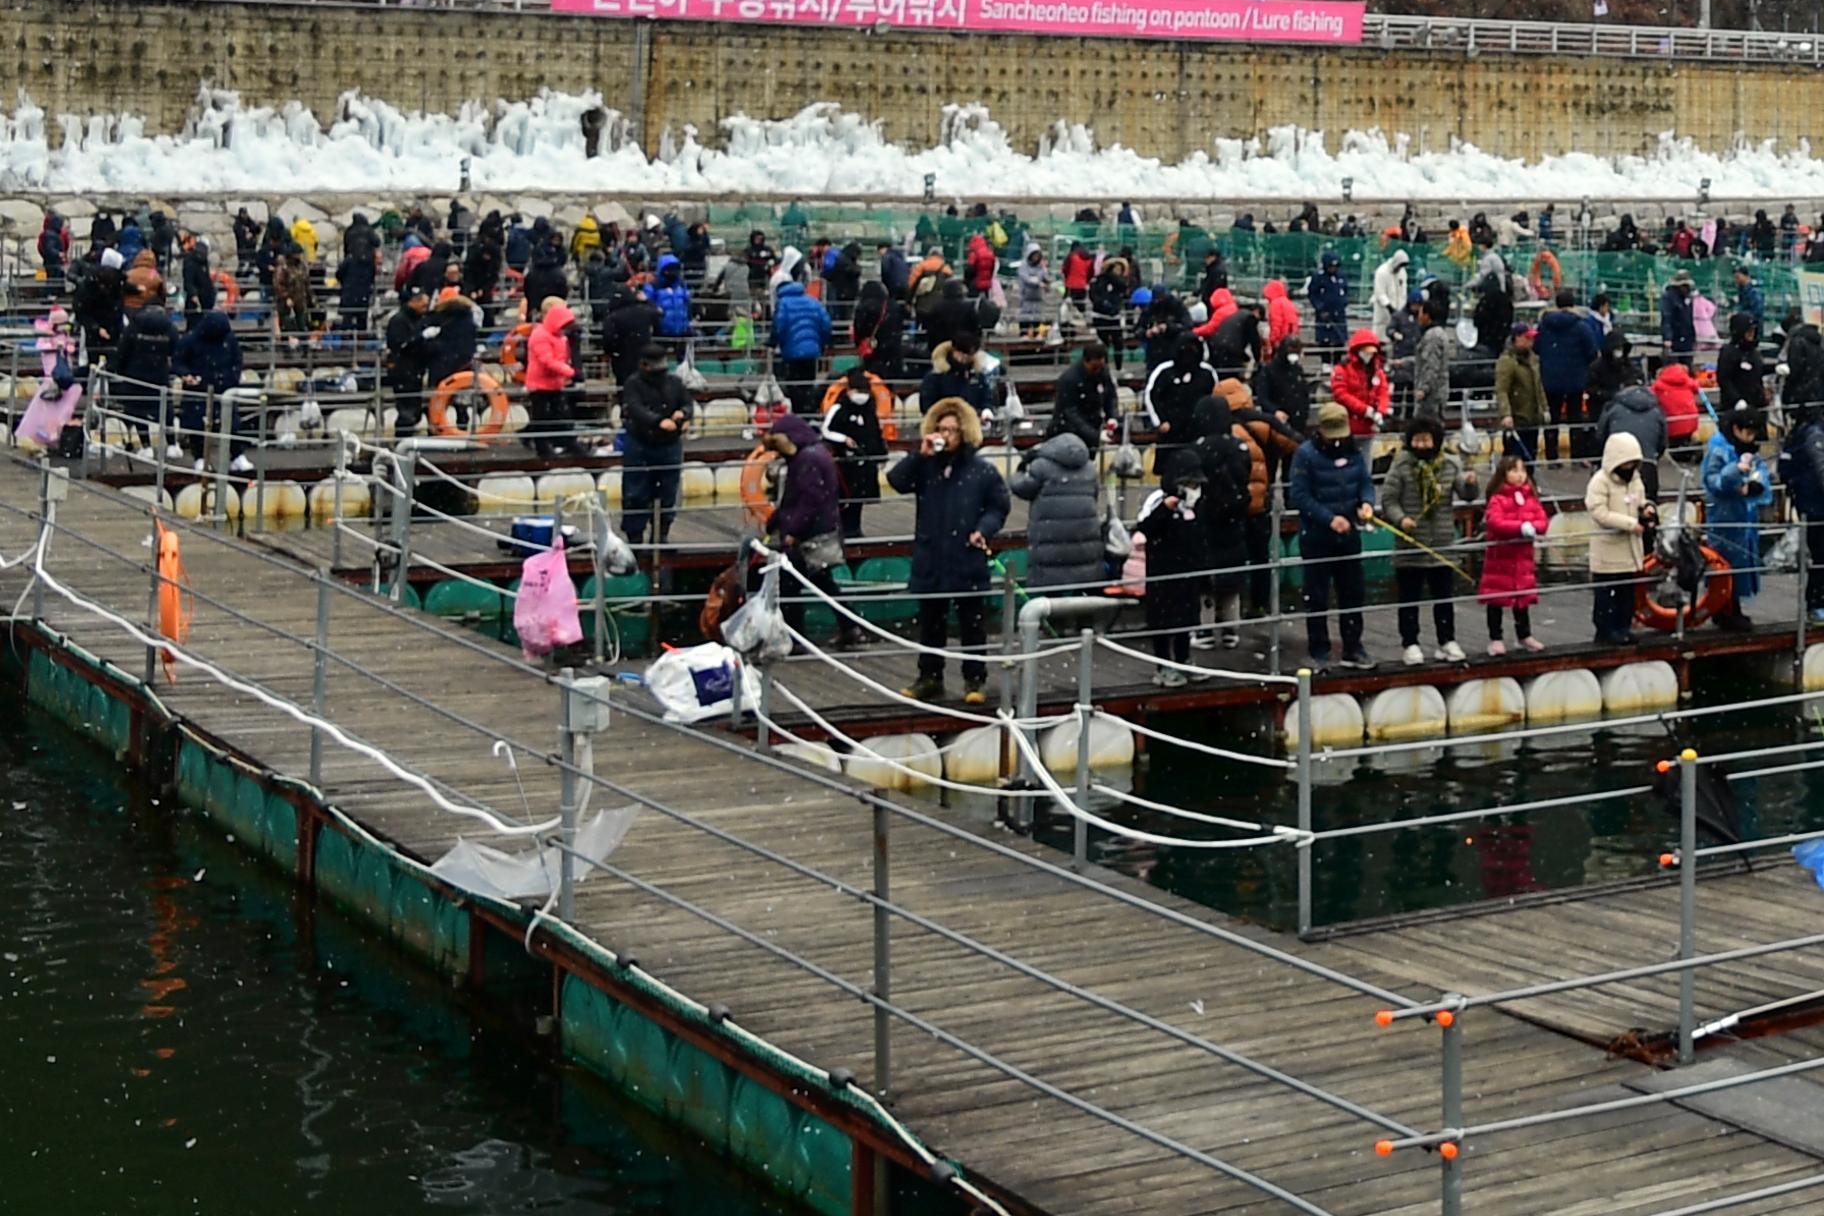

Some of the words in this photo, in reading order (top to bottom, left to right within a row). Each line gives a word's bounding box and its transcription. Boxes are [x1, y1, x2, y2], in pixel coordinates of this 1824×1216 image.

[1091, 0, 1148, 32] fishing
[1150, 8, 1171, 27] on
[1174, 7, 1240, 31] pontoon
[1253, 7, 1291, 31] Lure
[1292, 8, 1345, 38] fishing
